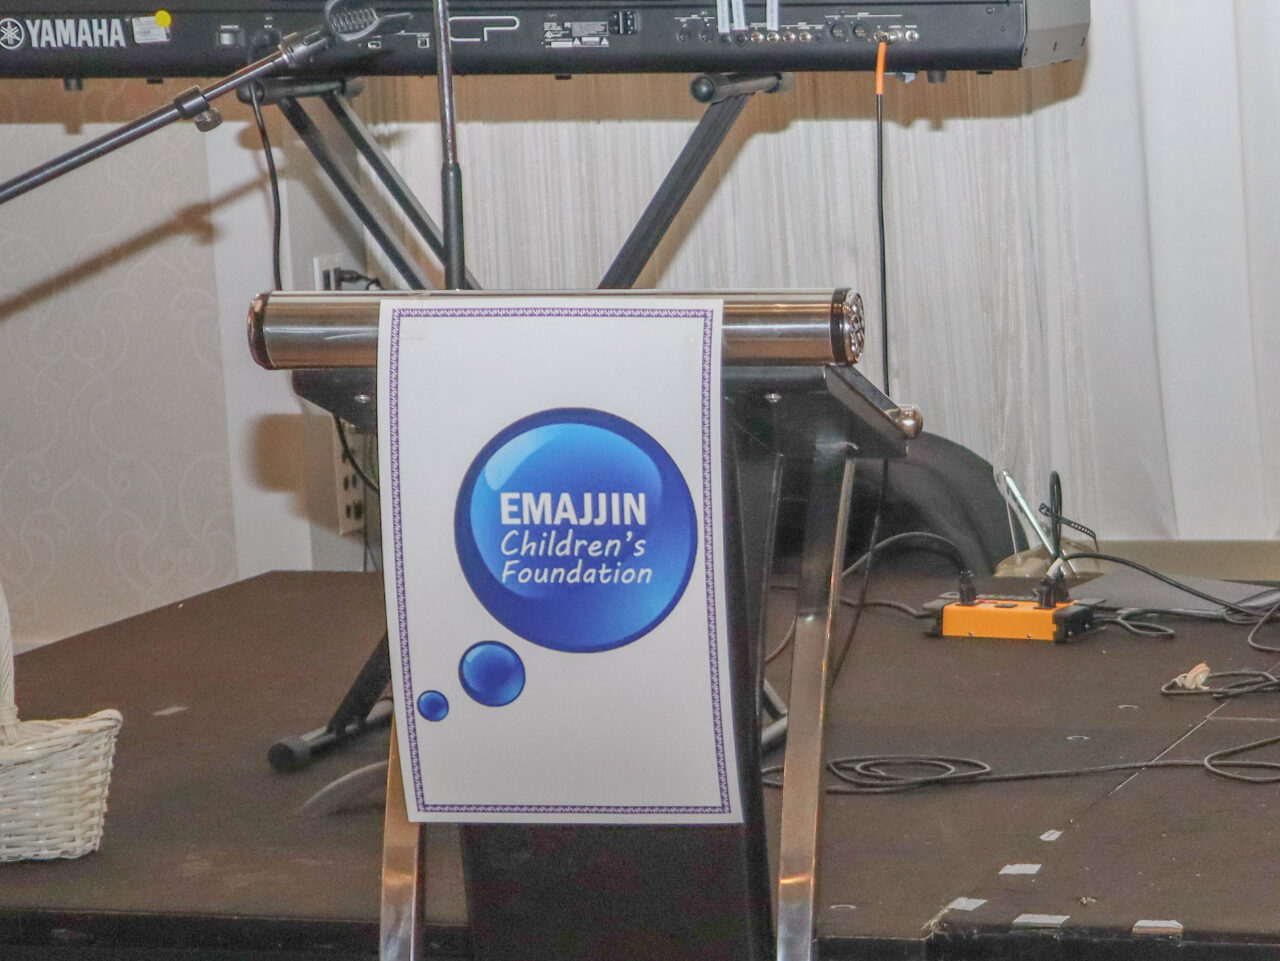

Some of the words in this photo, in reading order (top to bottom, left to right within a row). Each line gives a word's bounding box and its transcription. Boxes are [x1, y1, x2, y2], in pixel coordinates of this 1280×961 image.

[25, 18, 127, 48] YAMAHA
[500, 492, 647, 526] EMAJJIN
[500, 529, 647, 556] Children's
[502, 558, 653, 584] Foundation
